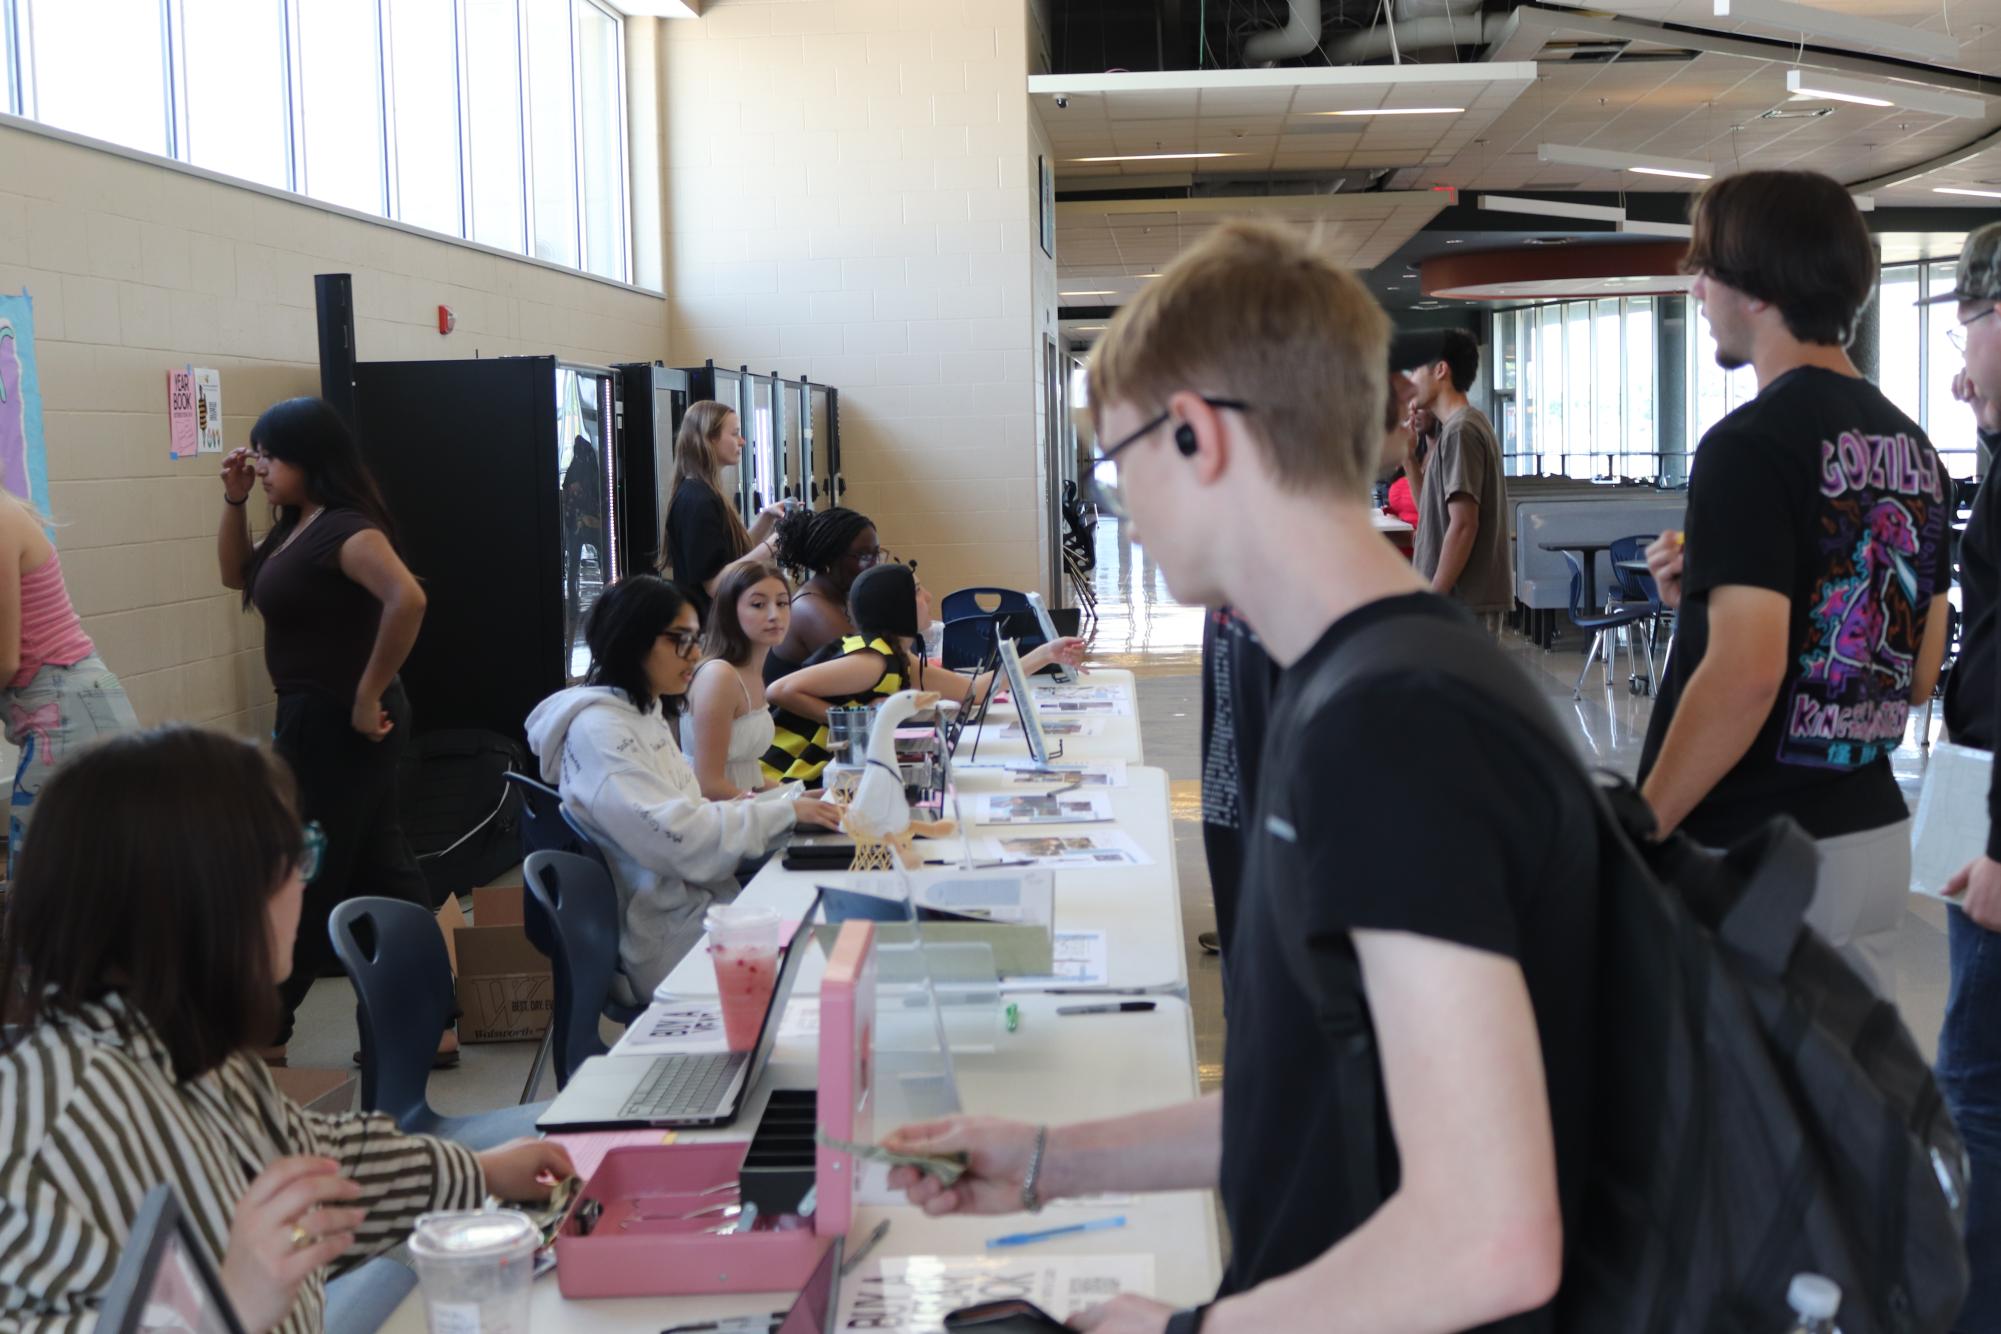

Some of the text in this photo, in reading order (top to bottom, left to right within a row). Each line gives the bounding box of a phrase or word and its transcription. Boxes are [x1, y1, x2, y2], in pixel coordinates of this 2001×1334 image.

[174, 373, 190, 391] YEAR
[173, 392, 192, 410] BOOK
[649, 1020, 696, 1037] BUY
[847, 1291, 906, 1329] BUY
